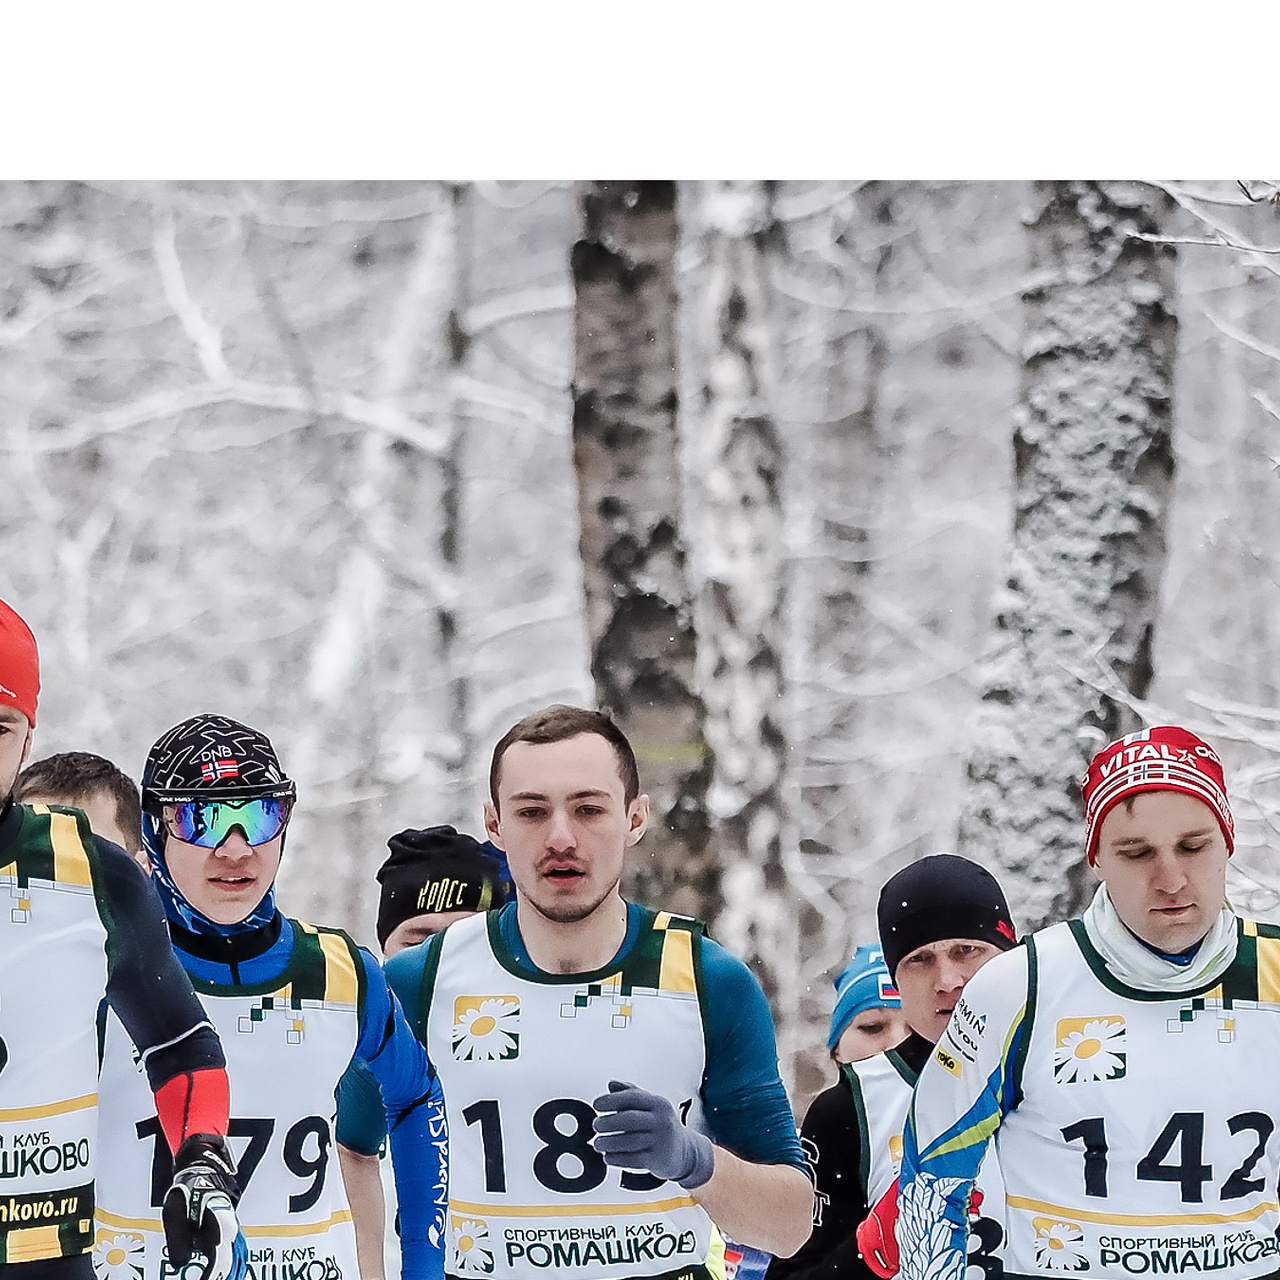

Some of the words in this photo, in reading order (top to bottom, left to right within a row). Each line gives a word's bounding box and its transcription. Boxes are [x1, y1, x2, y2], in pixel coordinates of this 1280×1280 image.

[201, 745, 233, 762] DNB
[1100, 744, 1177, 778] VITAL
[13, 1131, 51, 1148] КЛУБ
[461, 1098, 692, 1195] 18
[1060, 1111, 1274, 1203] 142
[503, 1225, 616, 1242] СПОРТИВНЫЙ
[625, 1222, 665, 1236] КЛУБ
[1098, 1233, 1216, 1250] СПОРТИВНЫЙ
[1223, 1229, 1256, 1245] КЛУБ
[281, 1246, 316, 1263] КЛУБ
